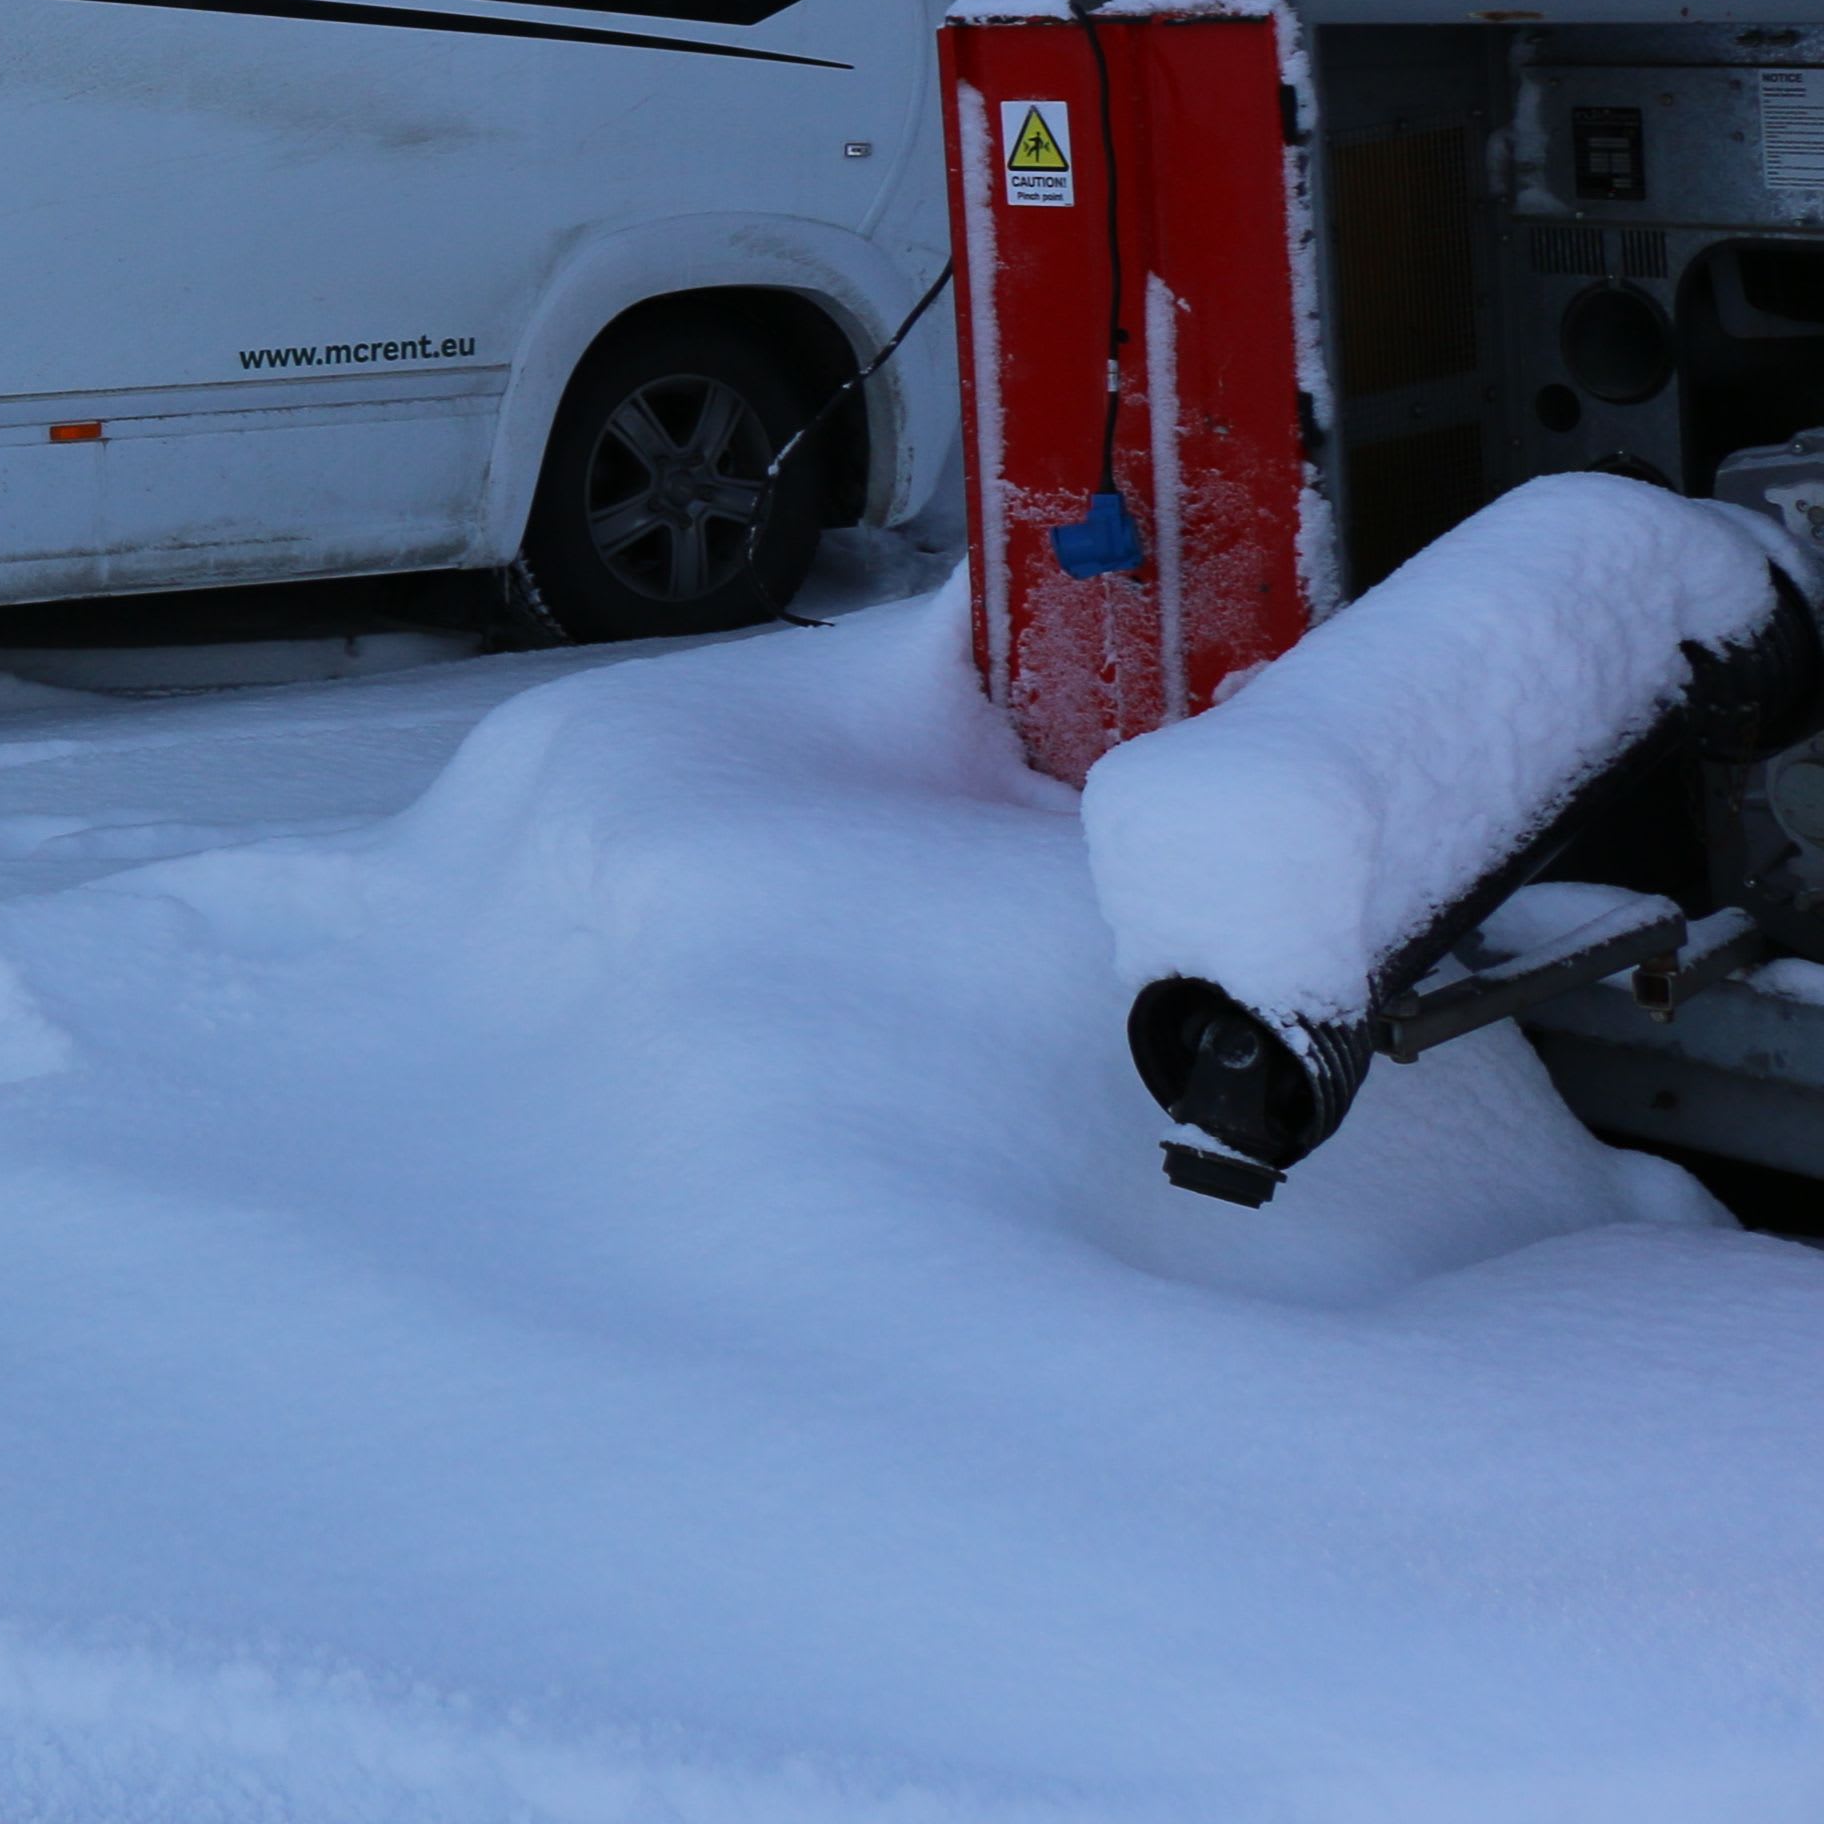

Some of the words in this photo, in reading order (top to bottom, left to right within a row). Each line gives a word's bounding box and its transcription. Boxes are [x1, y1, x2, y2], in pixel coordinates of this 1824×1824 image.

[1762, 73, 1803, 83] NOTICE
[1012, 176, 1067, 188] CAUTION!
[1017, 191, 1040, 200] Pinch
[239, 334, 476, 370] www.mcrent.eu
